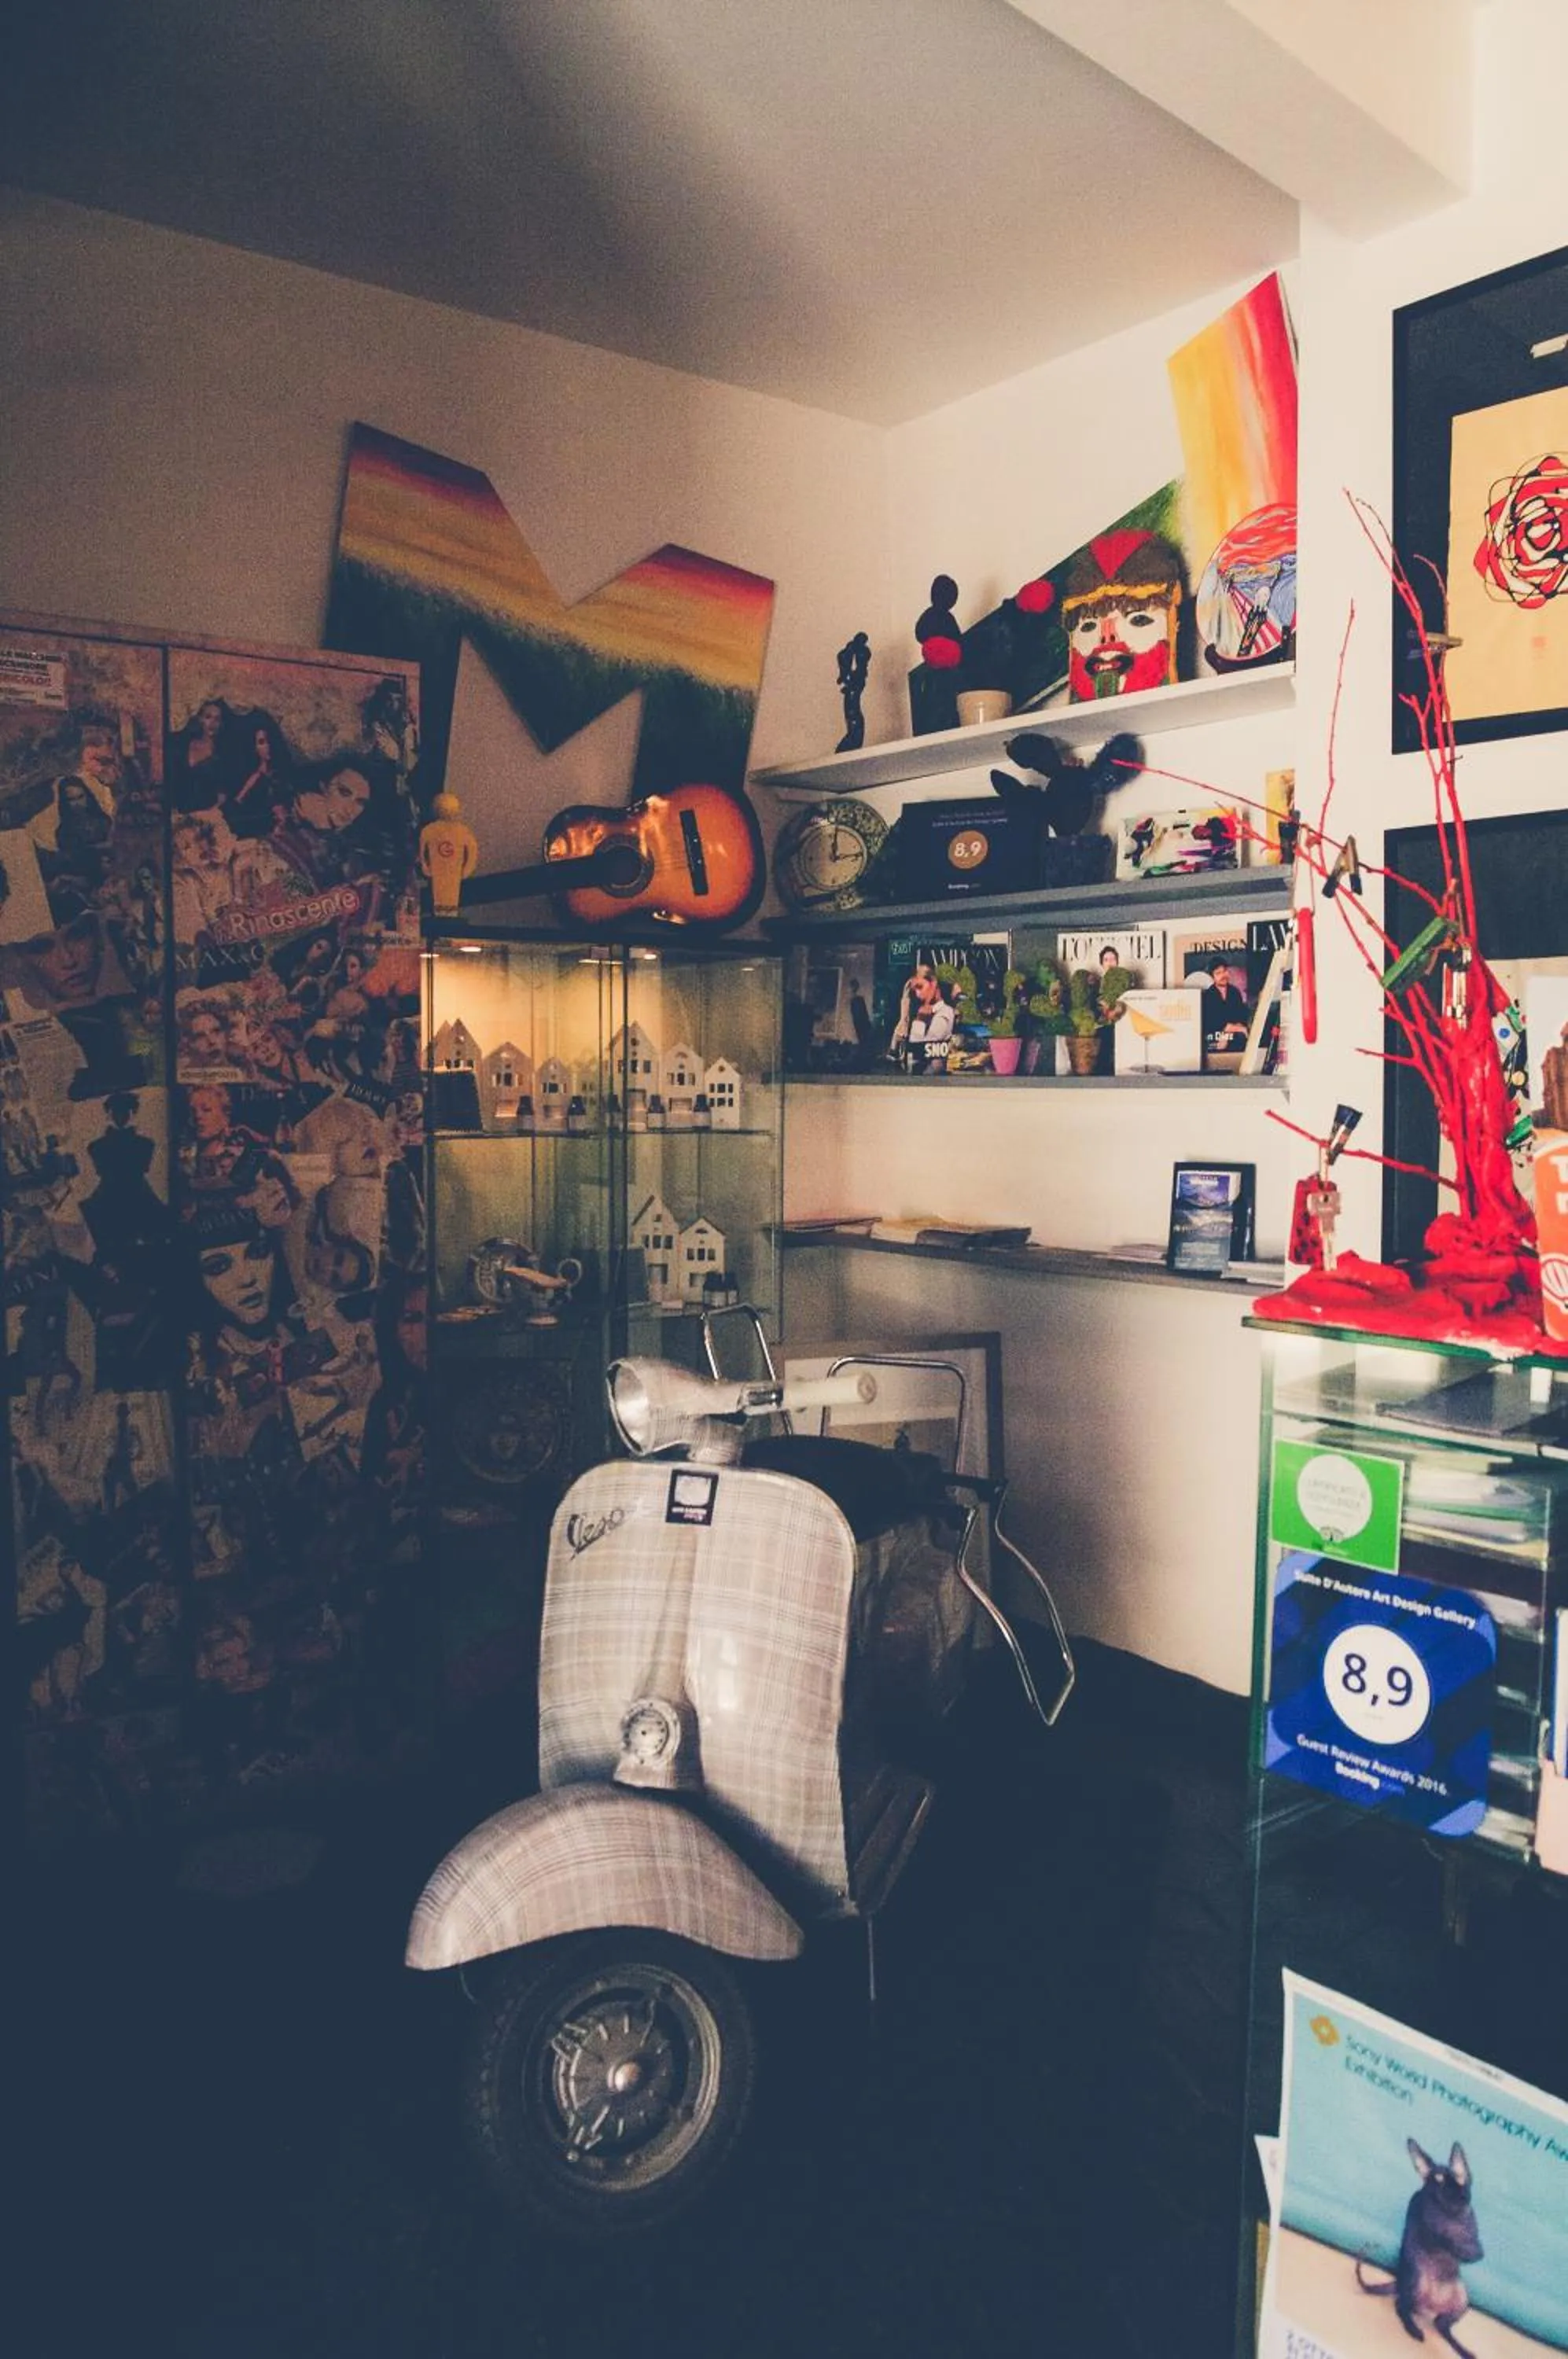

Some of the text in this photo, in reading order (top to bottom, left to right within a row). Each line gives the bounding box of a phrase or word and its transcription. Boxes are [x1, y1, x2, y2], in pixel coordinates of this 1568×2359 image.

[954, 841, 982, 858] 8,9
[1372, 1589, 1390, 1605] Art
[1392, 1595, 1432, 1616] Design
[1433, 1606, 1476, 1629] Gallery
[1342, 1653, 1413, 1706] 8,9
[1297, 1733, 1329, 1756] Guest
[1331, 1744, 1371, 1768] Review
[1371, 1761, 1415, 1785] Awards
[1346, 2033, 1382, 2066] Sony
[1384, 2053, 1427, 2089] World
[1431, 2078, 1541, 2149] Photography
